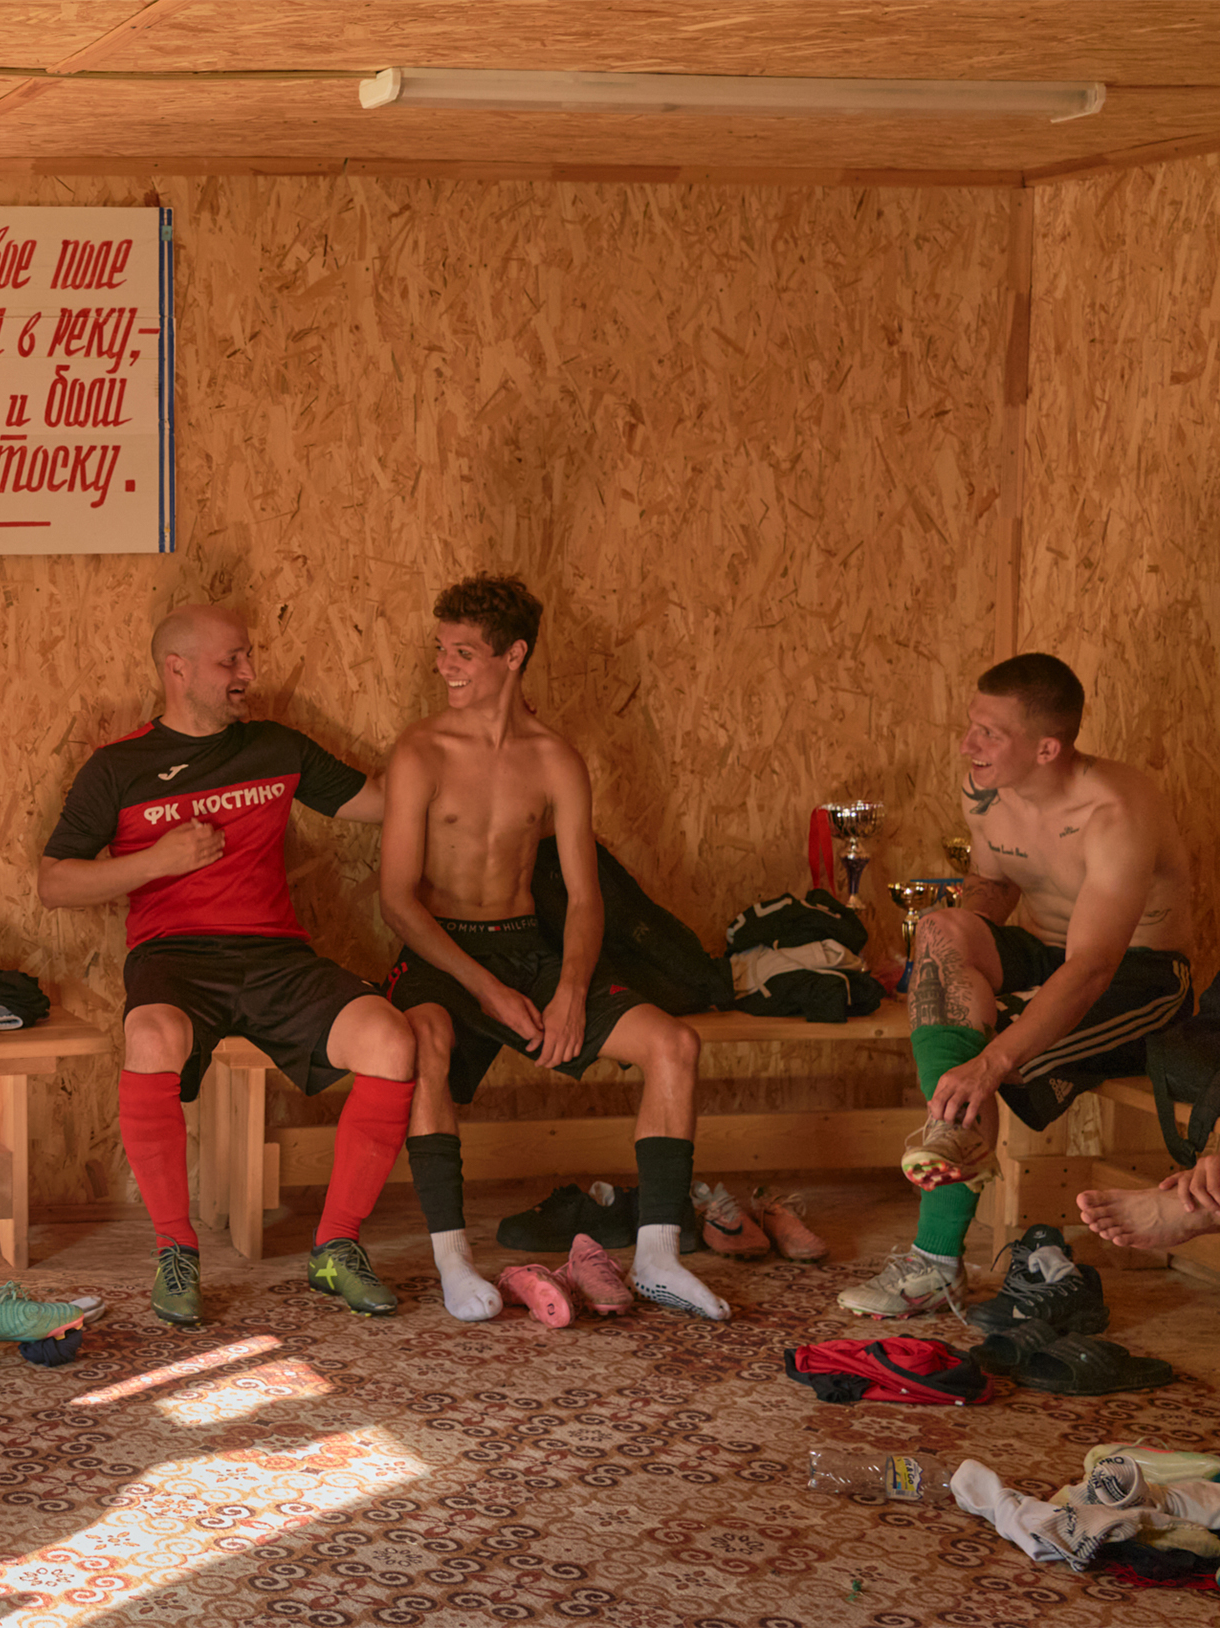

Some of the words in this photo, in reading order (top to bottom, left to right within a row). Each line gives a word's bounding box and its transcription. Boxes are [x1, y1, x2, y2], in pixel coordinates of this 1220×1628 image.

[50, 238, 134, 290] поле
[17, 312, 43, 358] в
[5, 394, 32, 428] и
[44, 364, 132, 428] боли
[143, 803, 181, 825] ФК
[192, 783, 286, 816] КОСТИНО
